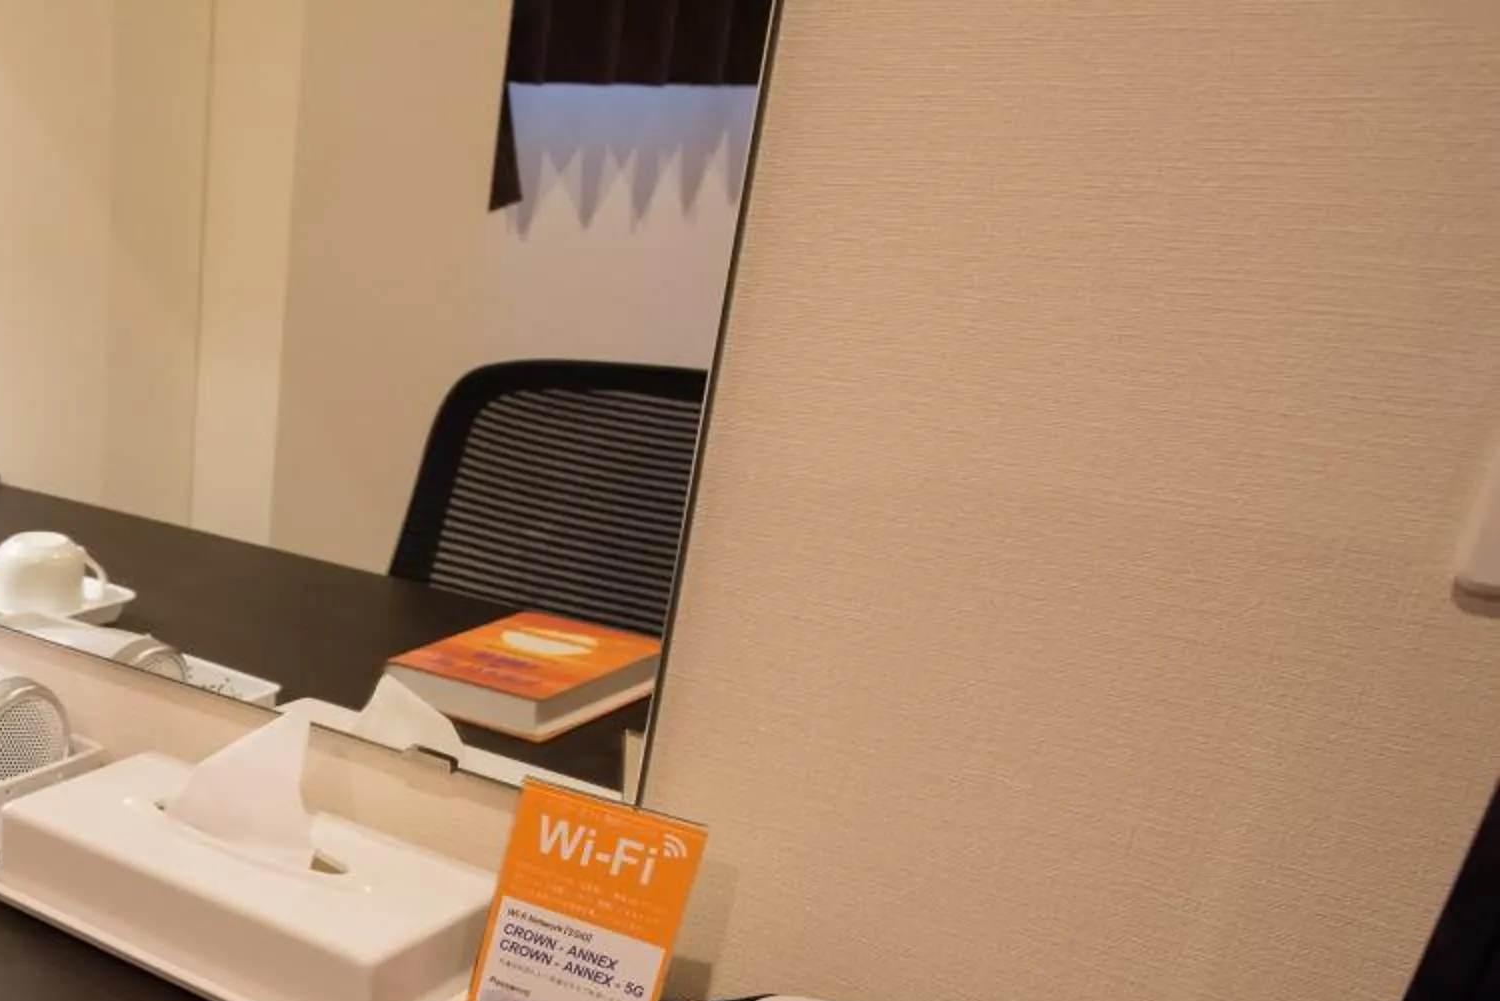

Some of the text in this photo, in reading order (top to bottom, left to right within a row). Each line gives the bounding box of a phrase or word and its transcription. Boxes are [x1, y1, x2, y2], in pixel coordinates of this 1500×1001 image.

[538, 814, 659, 887] Wi-Fi
[500, 939, 553, 966] CROWN
[562, 961, 614, 988] ANNEX
[624, 981, 645, 998] 5G
[503, 923, 557, 950] CROWN
[567, 945, 619, 970] ANNEX
